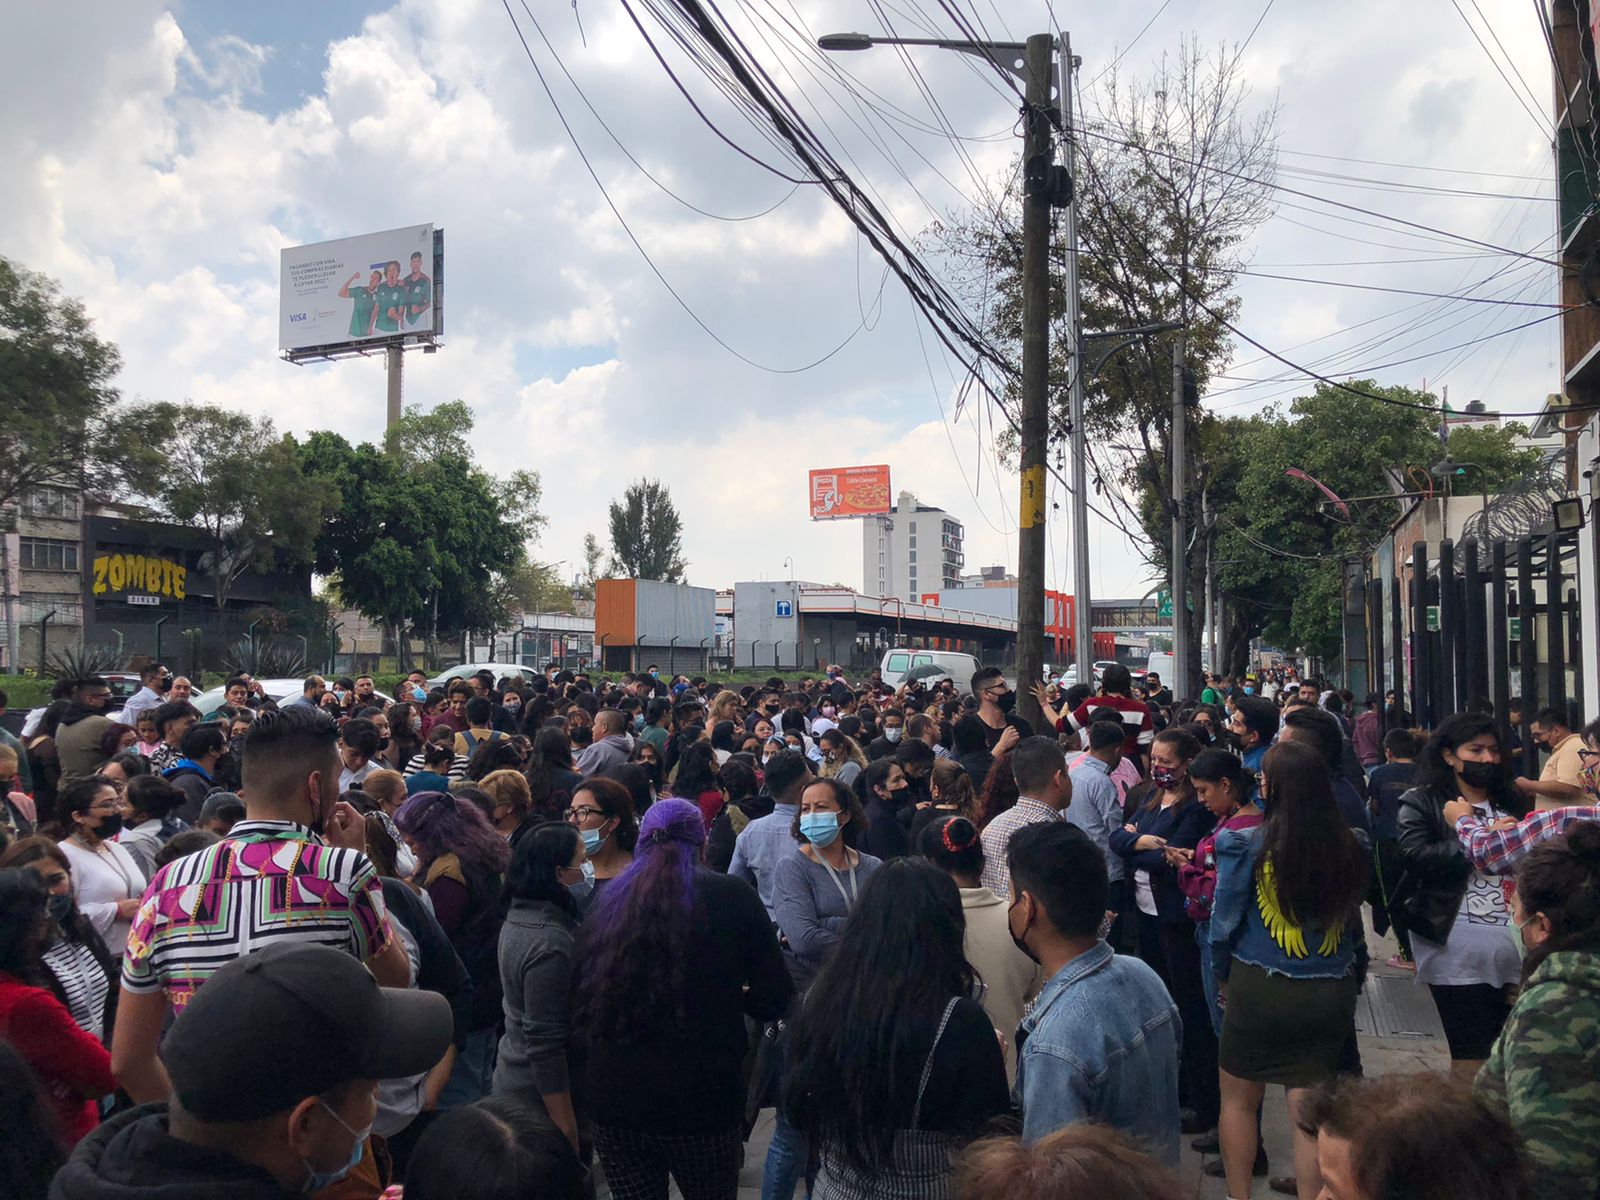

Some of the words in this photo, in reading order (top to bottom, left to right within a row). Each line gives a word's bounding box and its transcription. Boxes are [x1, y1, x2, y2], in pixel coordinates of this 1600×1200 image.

[301, 267, 324, 275] COMPRAS
[324, 263, 344, 271] DIARIAS
[299, 273, 317, 281] PUEDEN
[317, 270, 336, 279] LLEVAR
[289, 313, 307, 323] VISA
[93, 554, 186, 600] ZOMBIE
